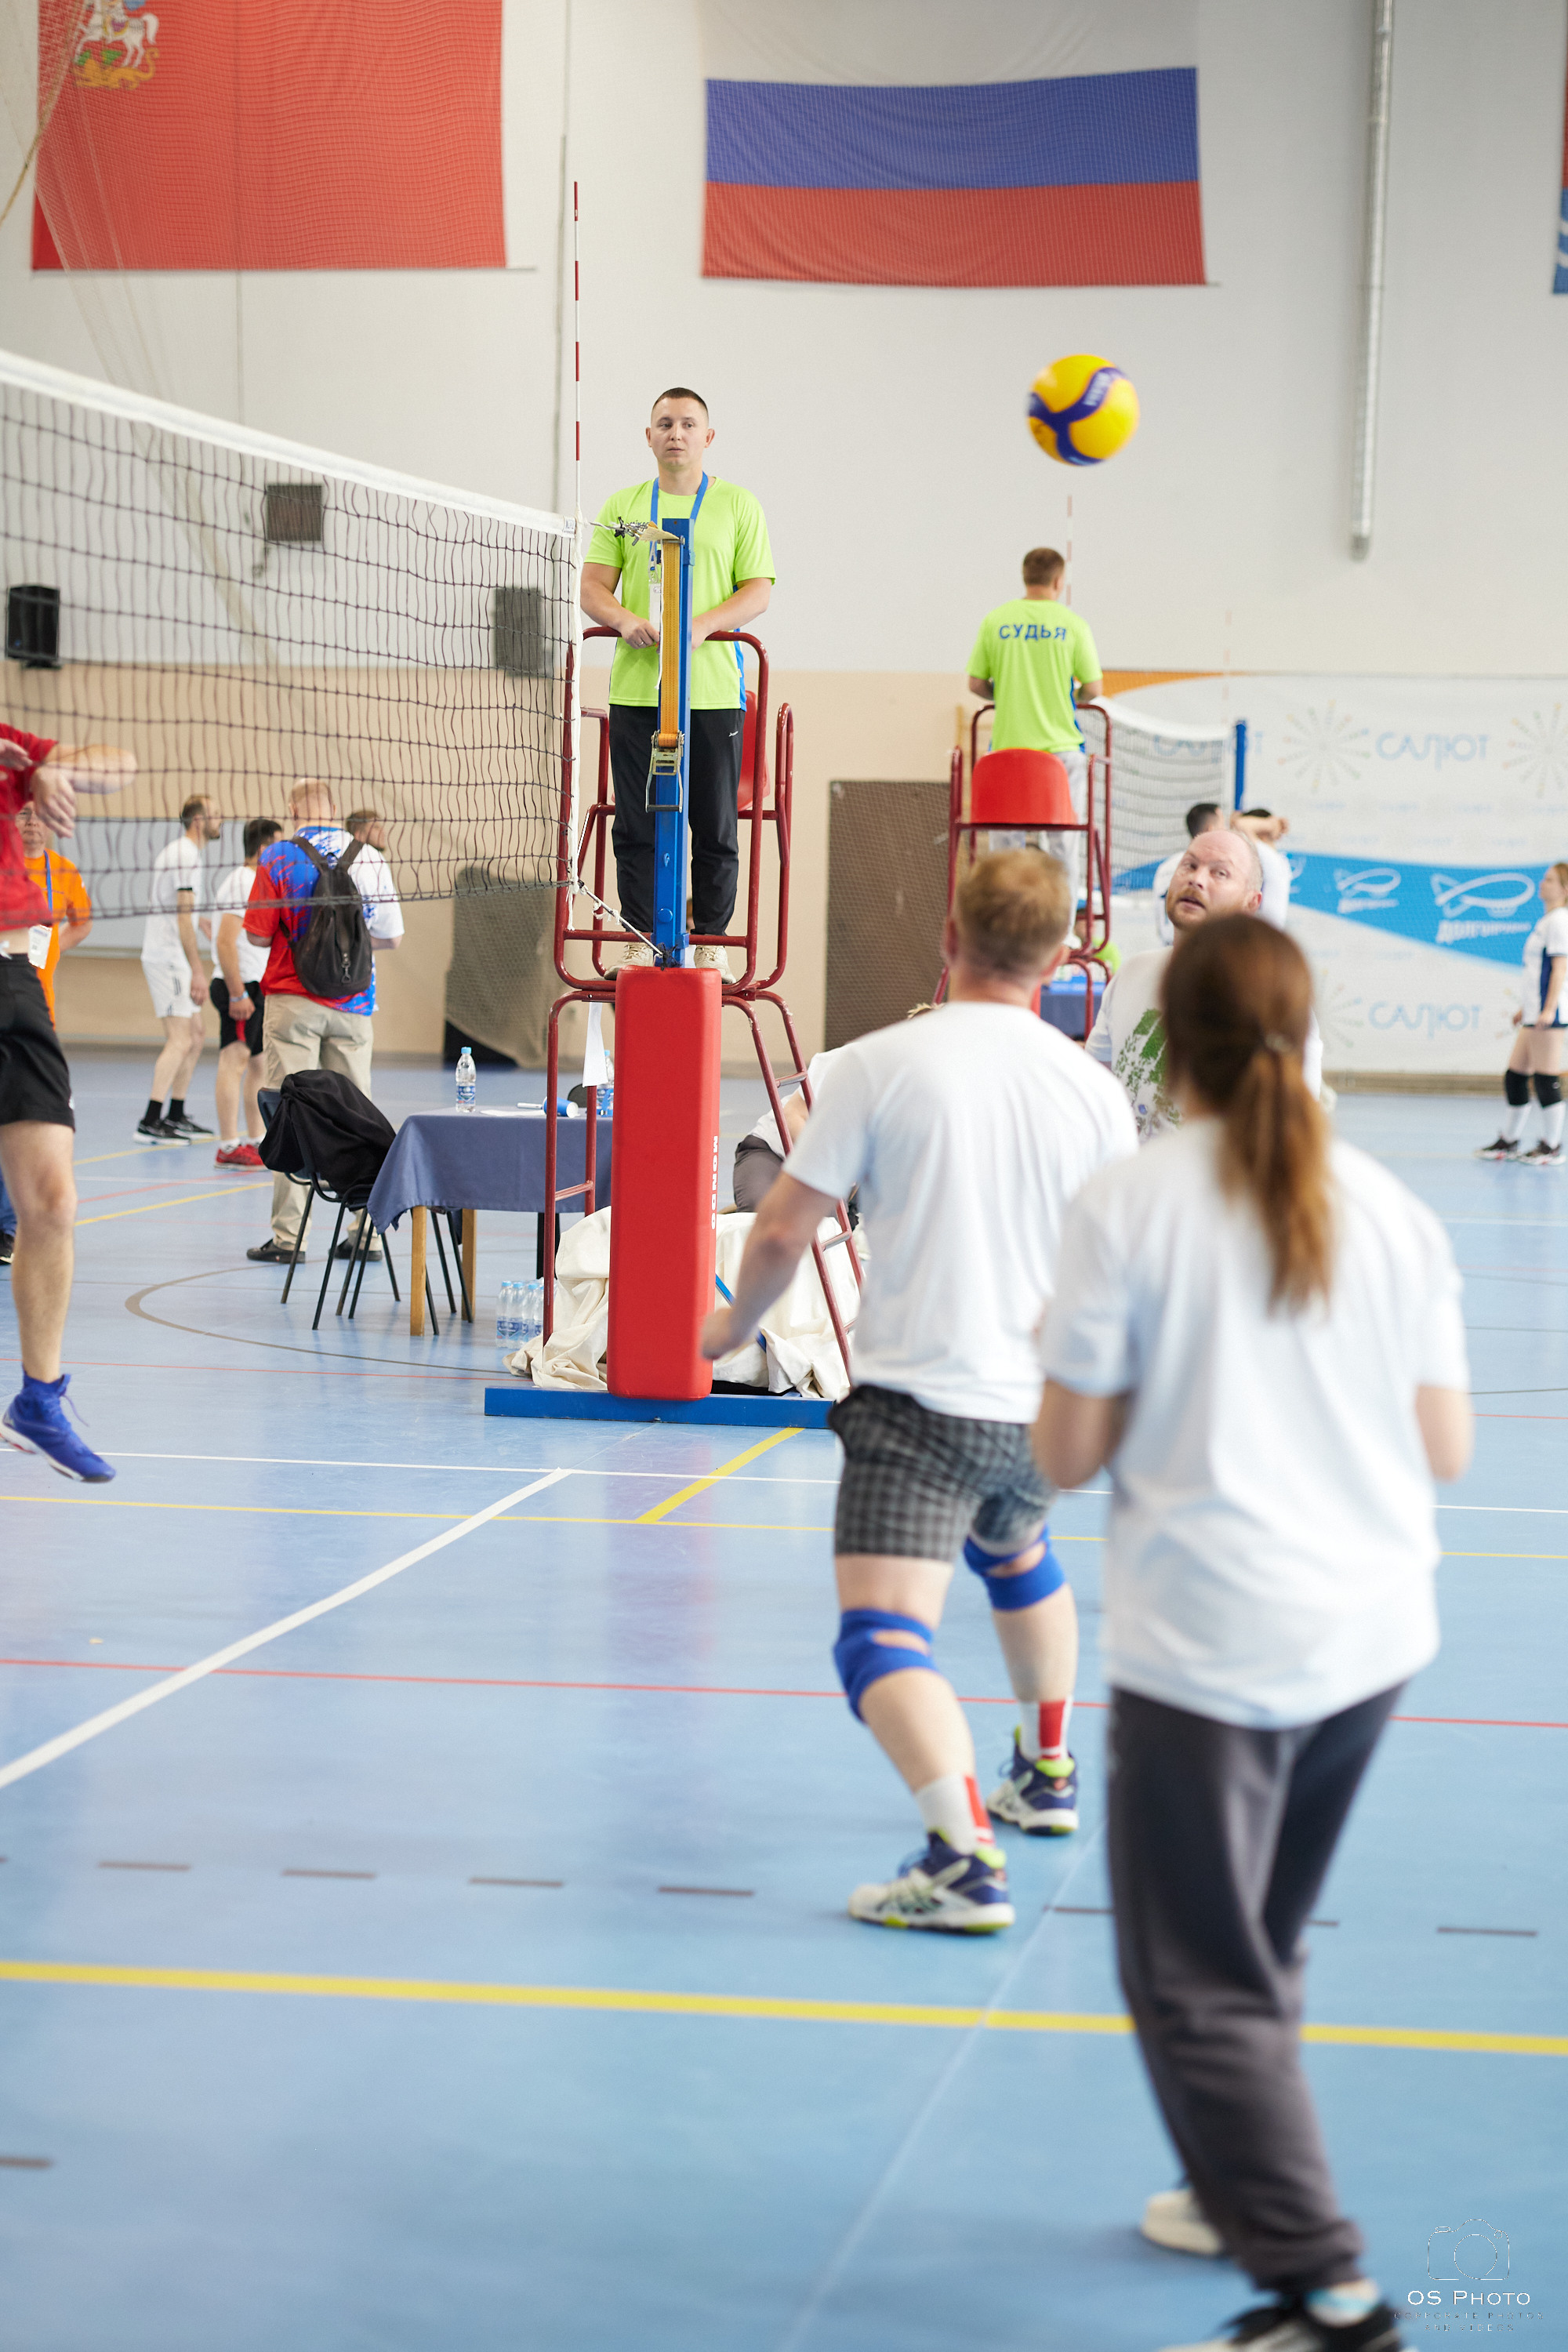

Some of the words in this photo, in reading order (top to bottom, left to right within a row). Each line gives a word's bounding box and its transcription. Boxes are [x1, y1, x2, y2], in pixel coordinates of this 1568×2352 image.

[999, 624, 1066, 641] СУДЬЯ
[1375, 731, 1490, 769] САЛЮТ
[1367, 1000, 1482, 1039] САЛЮТ
